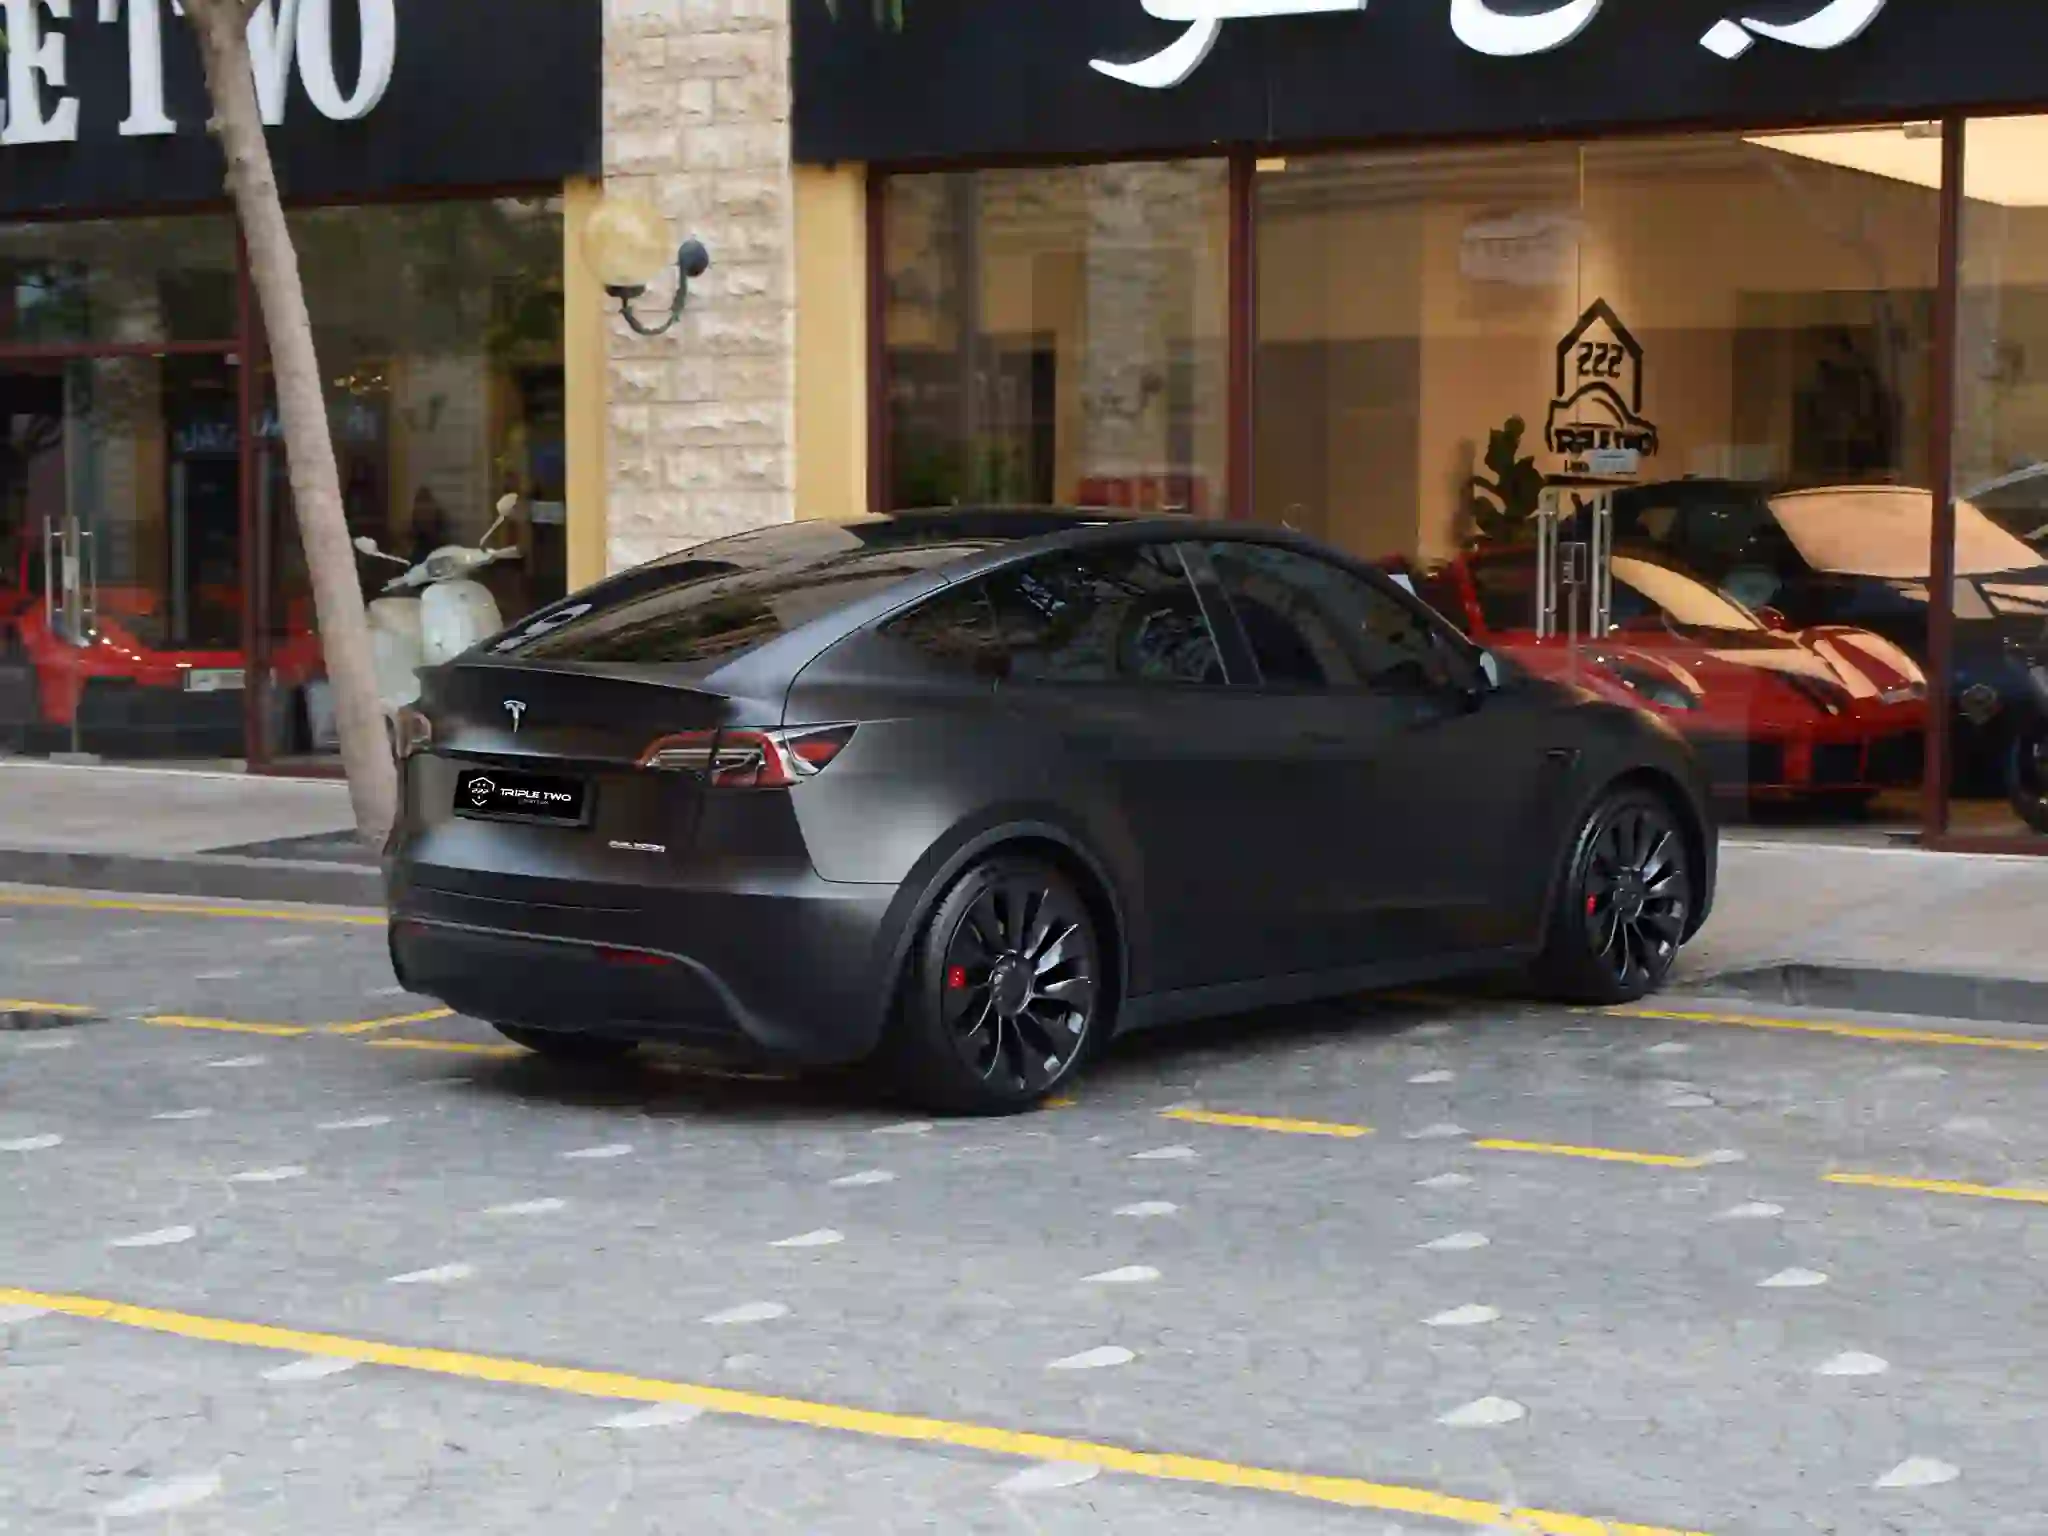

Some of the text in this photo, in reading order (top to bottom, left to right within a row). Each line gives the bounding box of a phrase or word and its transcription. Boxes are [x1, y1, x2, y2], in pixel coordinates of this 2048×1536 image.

[0, 0, 79, 145] E
[499, 788, 541, 799] TRIPLE
[543, 791, 572, 802] TWO
